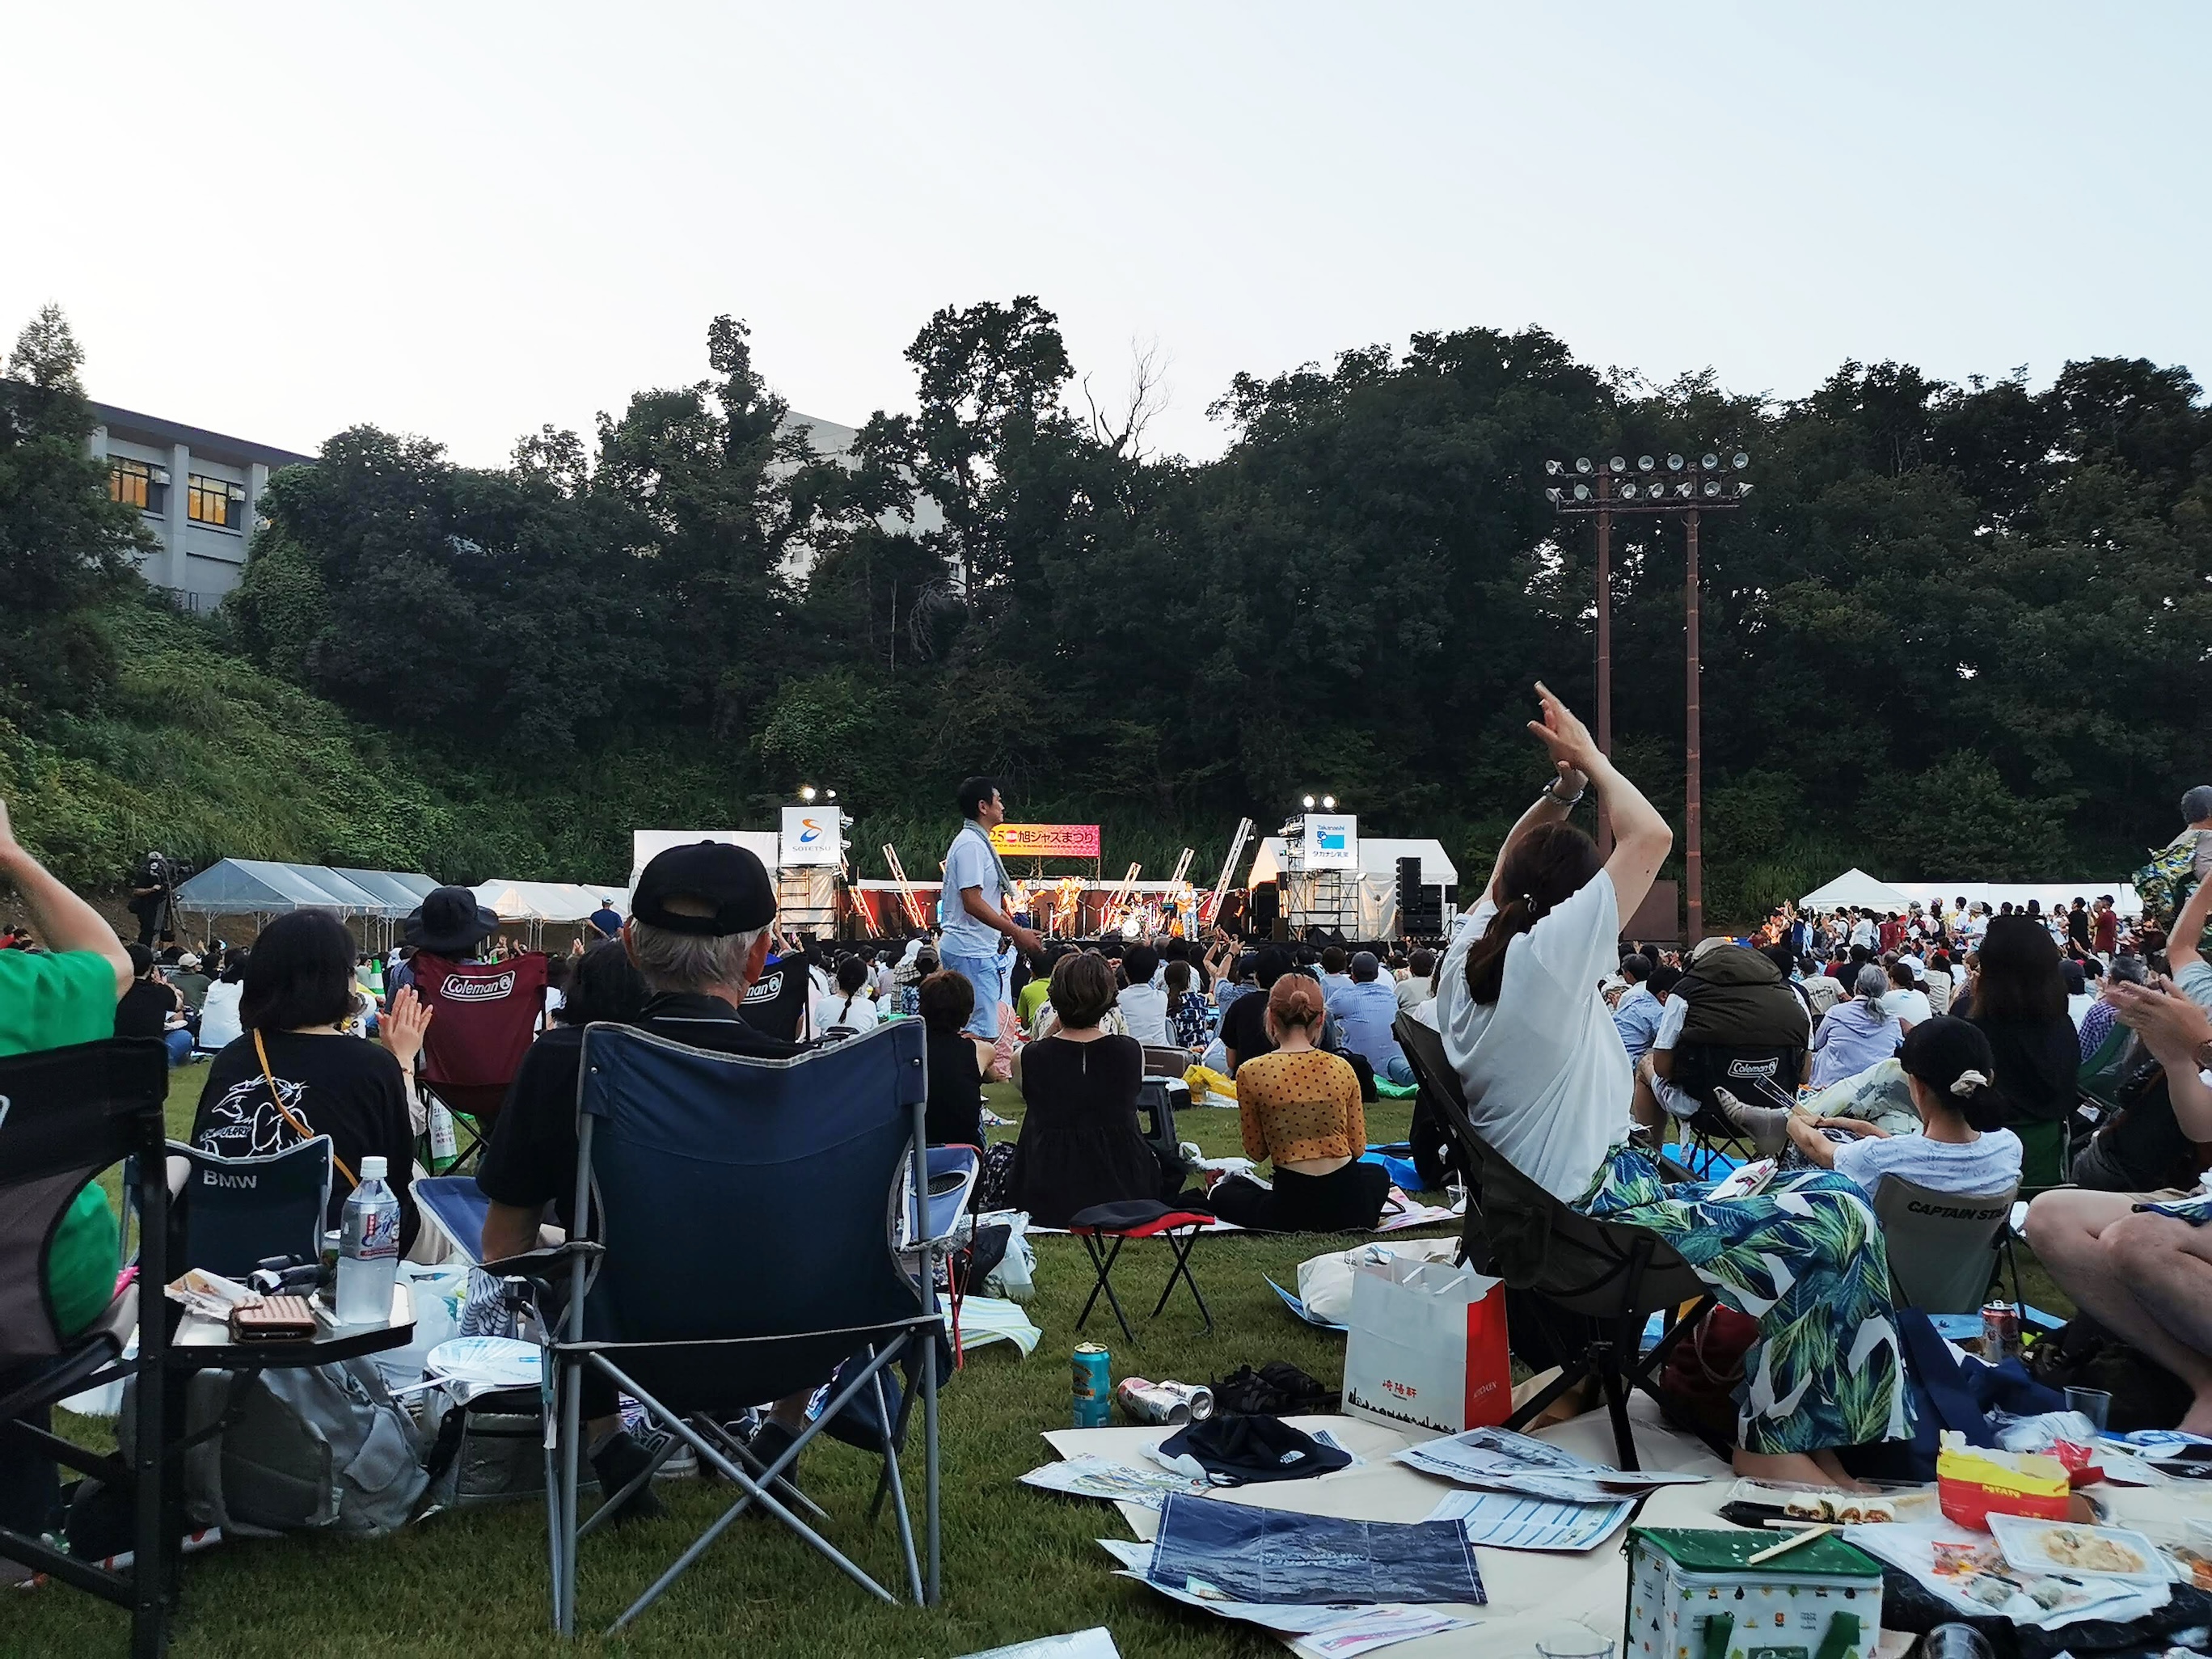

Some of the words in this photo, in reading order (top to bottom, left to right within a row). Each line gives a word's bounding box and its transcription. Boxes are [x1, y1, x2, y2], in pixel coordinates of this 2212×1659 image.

[447, 977, 500, 994] Coleman
[203, 1169, 257, 1188] BMW
[1906, 1200, 1975, 1220] CAPTAIN
